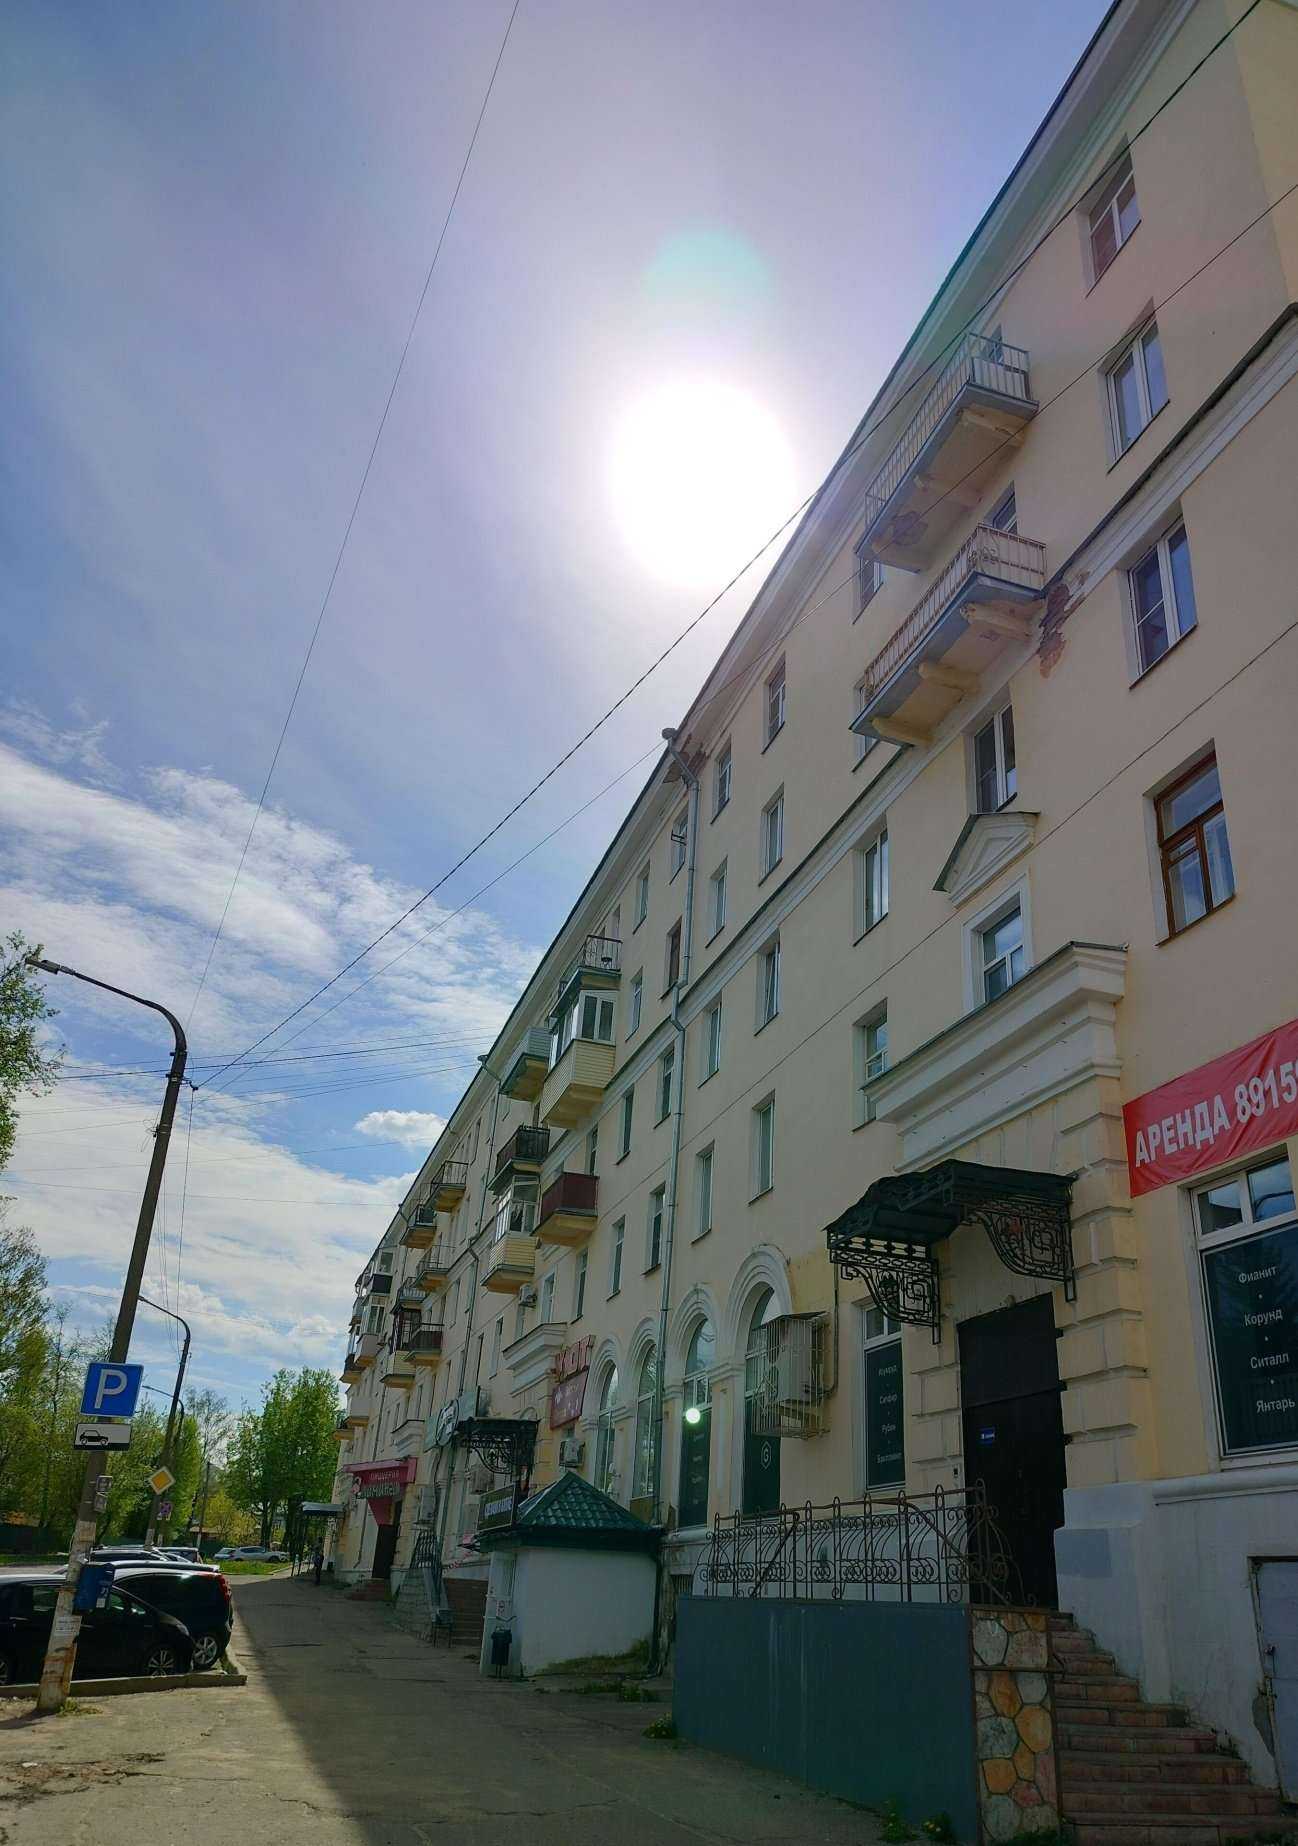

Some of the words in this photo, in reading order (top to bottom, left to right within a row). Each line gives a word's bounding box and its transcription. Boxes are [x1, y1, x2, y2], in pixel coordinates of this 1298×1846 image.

[1135, 1094, 1231, 1168] АРЕНДА
[1234, 1061, 1298, 1123] 8915
[1238, 1266, 1277, 1283] Фианит
[1243, 1308, 1283, 1326] Корунд
[1250, 1352, 1289, 1369] Ситалл
[94, 1369, 127, 1408] P
[1256, 1397, 1296, 1414] Янтарь
